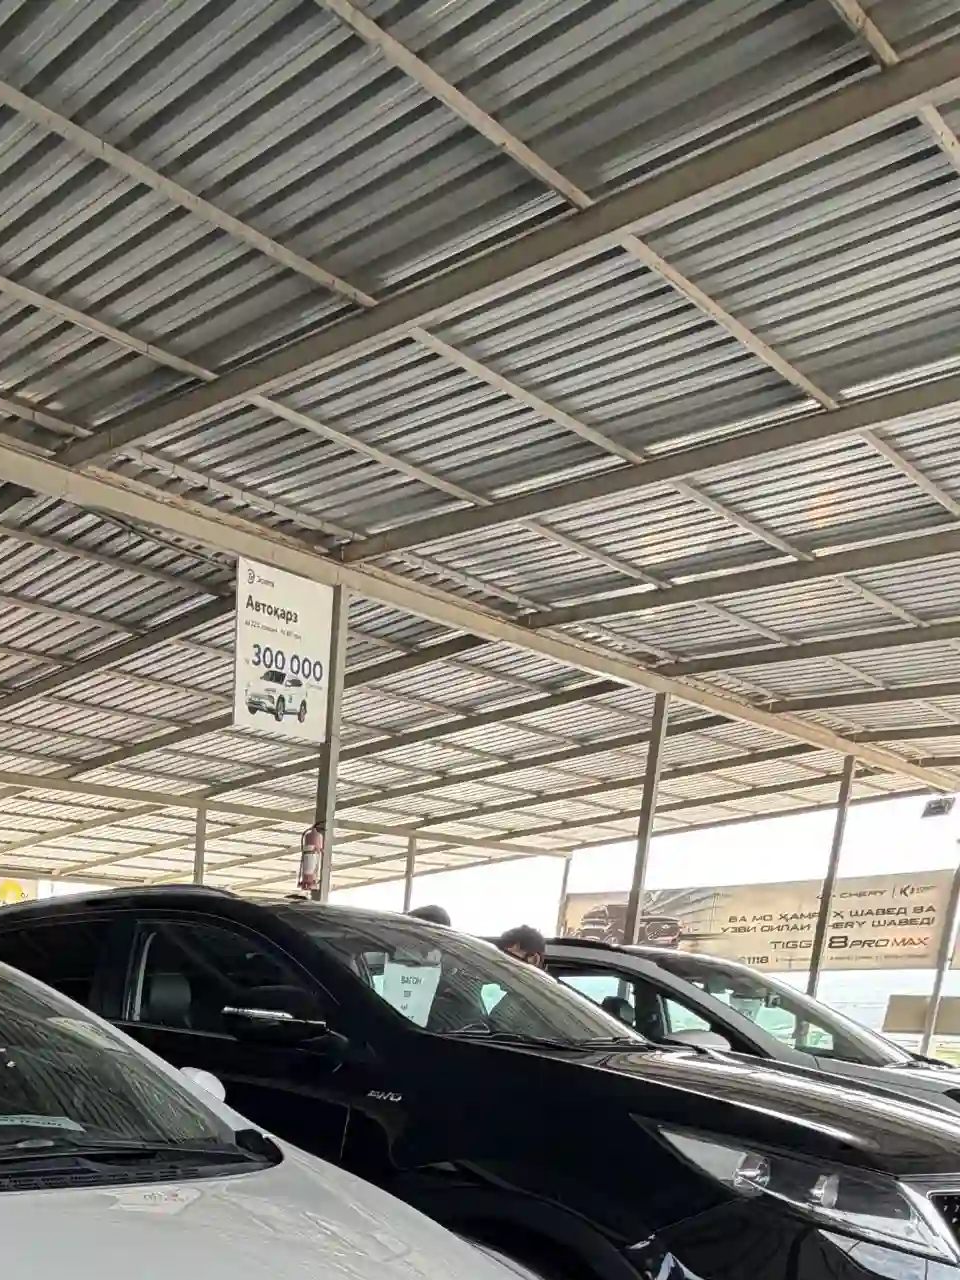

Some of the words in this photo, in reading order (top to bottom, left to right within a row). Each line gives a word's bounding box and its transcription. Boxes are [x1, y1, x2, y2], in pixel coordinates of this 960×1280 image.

[245, 594, 299, 624] Автоқарз
[251, 643, 286, 671] 300
[290, 654, 323, 681] 000
[849, 906, 908, 918] ШАВЕД
[828, 935, 848, 949] 8
